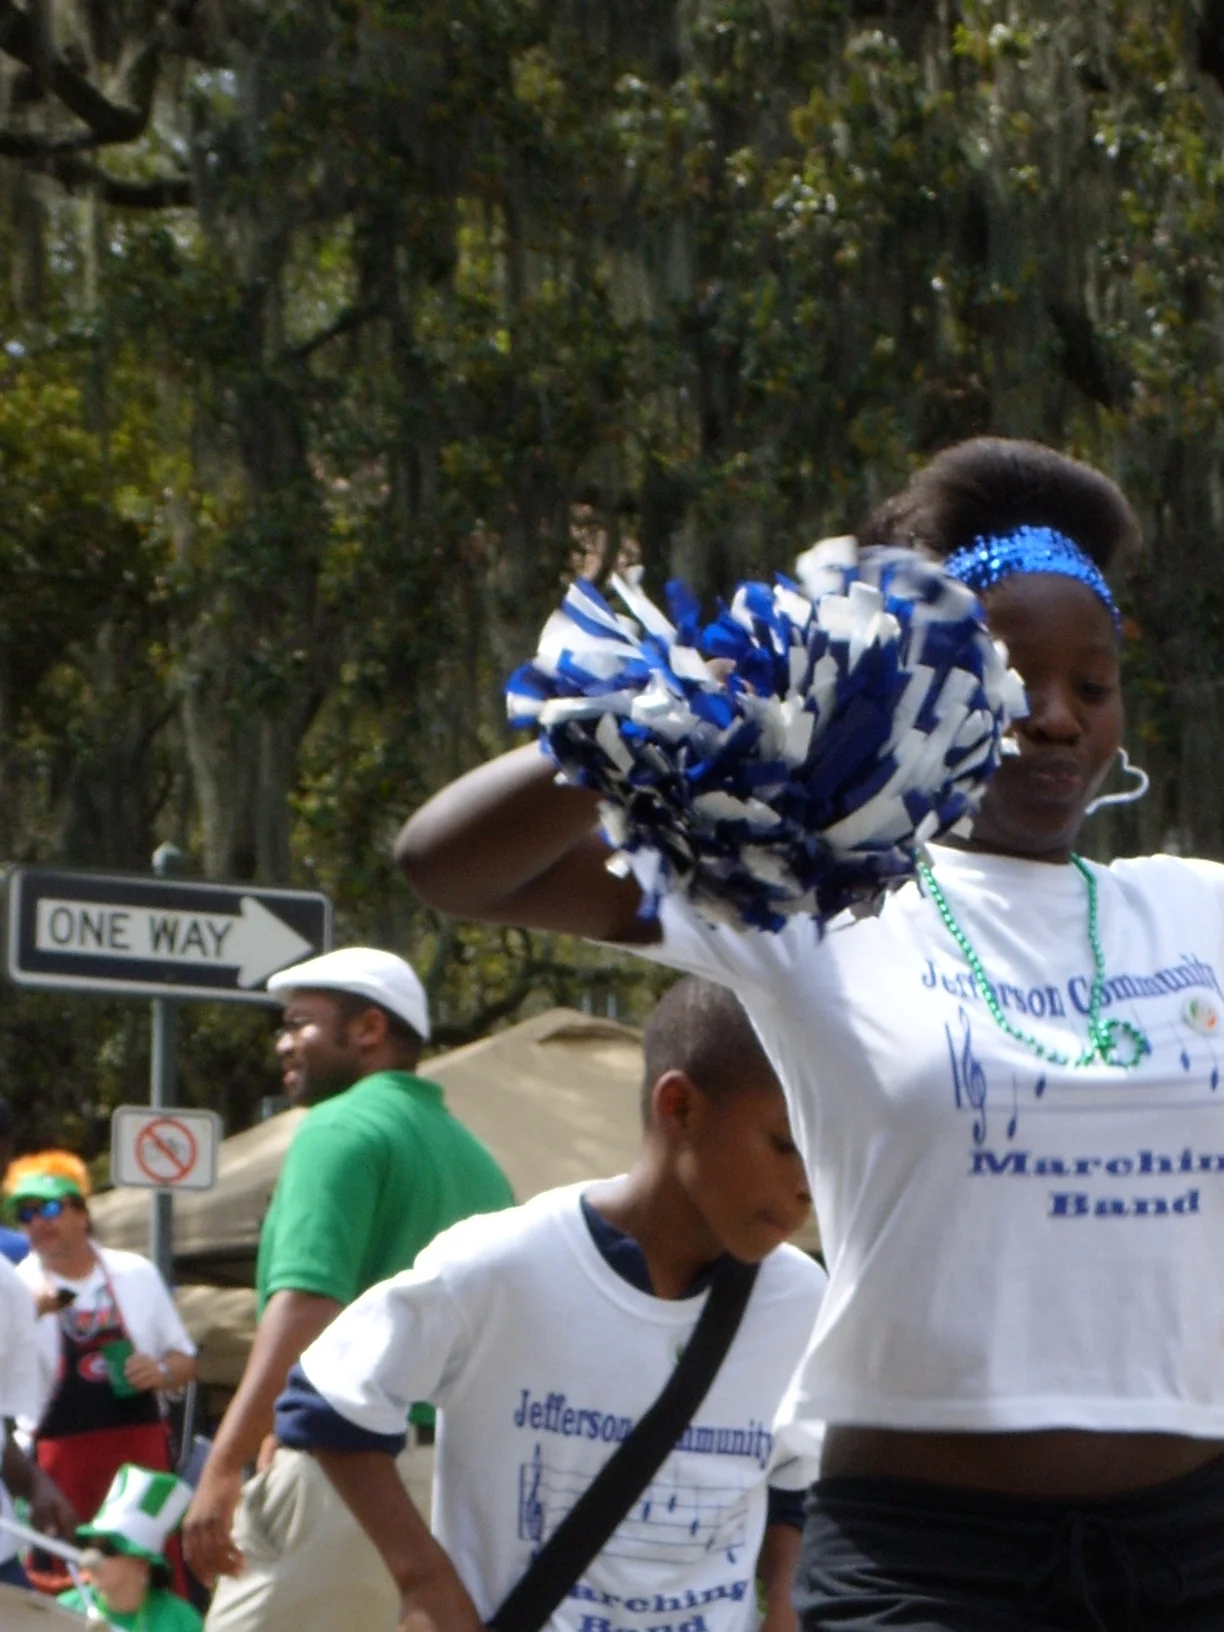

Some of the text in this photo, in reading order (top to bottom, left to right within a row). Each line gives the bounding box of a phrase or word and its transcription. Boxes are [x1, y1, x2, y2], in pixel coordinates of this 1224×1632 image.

[50, 906, 233, 957] ONE WAY
[1048, 1188, 1200, 1218] Band
[675, 1418, 774, 1469] mmunity
[571, 1580, 749, 1612] arching
